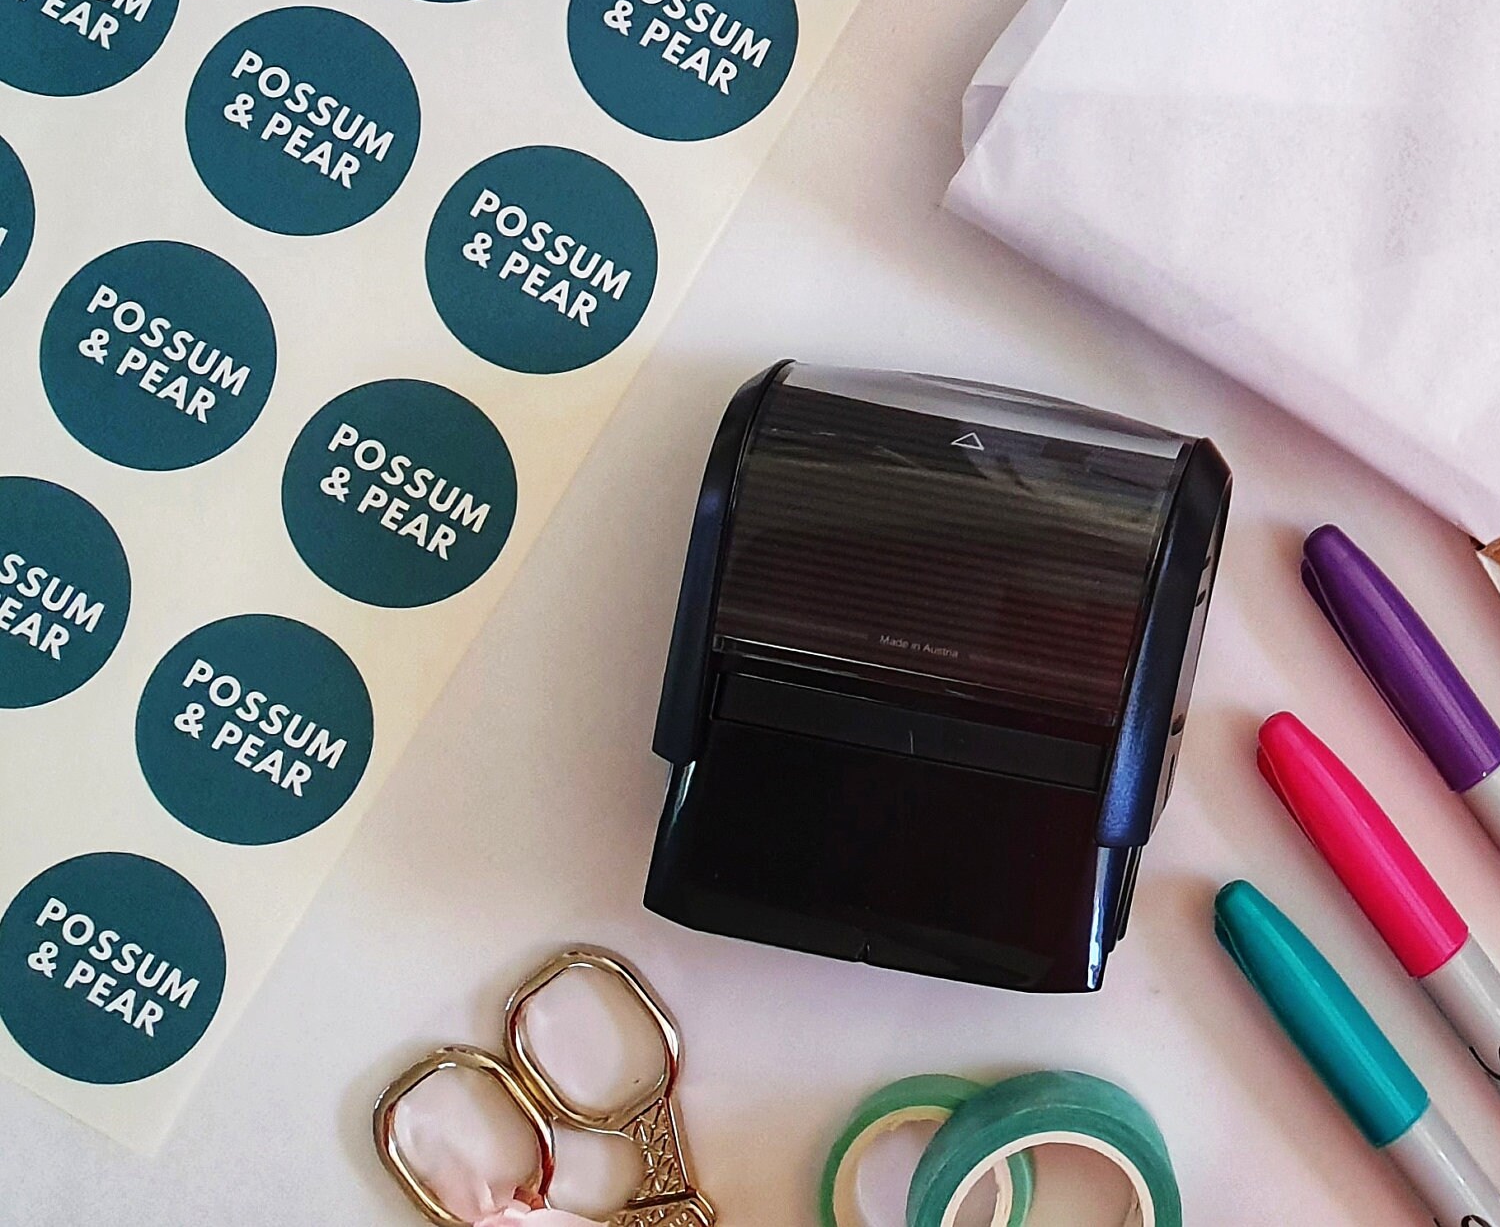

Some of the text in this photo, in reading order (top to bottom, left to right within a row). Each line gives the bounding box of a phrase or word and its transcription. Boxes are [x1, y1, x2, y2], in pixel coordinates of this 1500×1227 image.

[603, 0, 738, 95] & PEAR
[223, 93, 361, 189] & PEAR
[231, 49, 395, 162] POSSUM
[462, 232, 598, 328] & PEAR
[469, 188, 632, 300] POSSUM
[78, 328, 216, 424] & PEAR
[86, 284, 251, 397] POSSUM
[319, 466, 457, 561] & PEAR
[327, 422, 491, 534] POSSUM
[0, 553, 104, 633] SSUM
[0, 596, 70, 661] EAR
[173, 702, 312, 797] & PEAR
[182, 658, 348, 770] POSSUM
[27, 941, 164, 1038] & PEAR
[35, 897, 200, 1009] POSSUM
